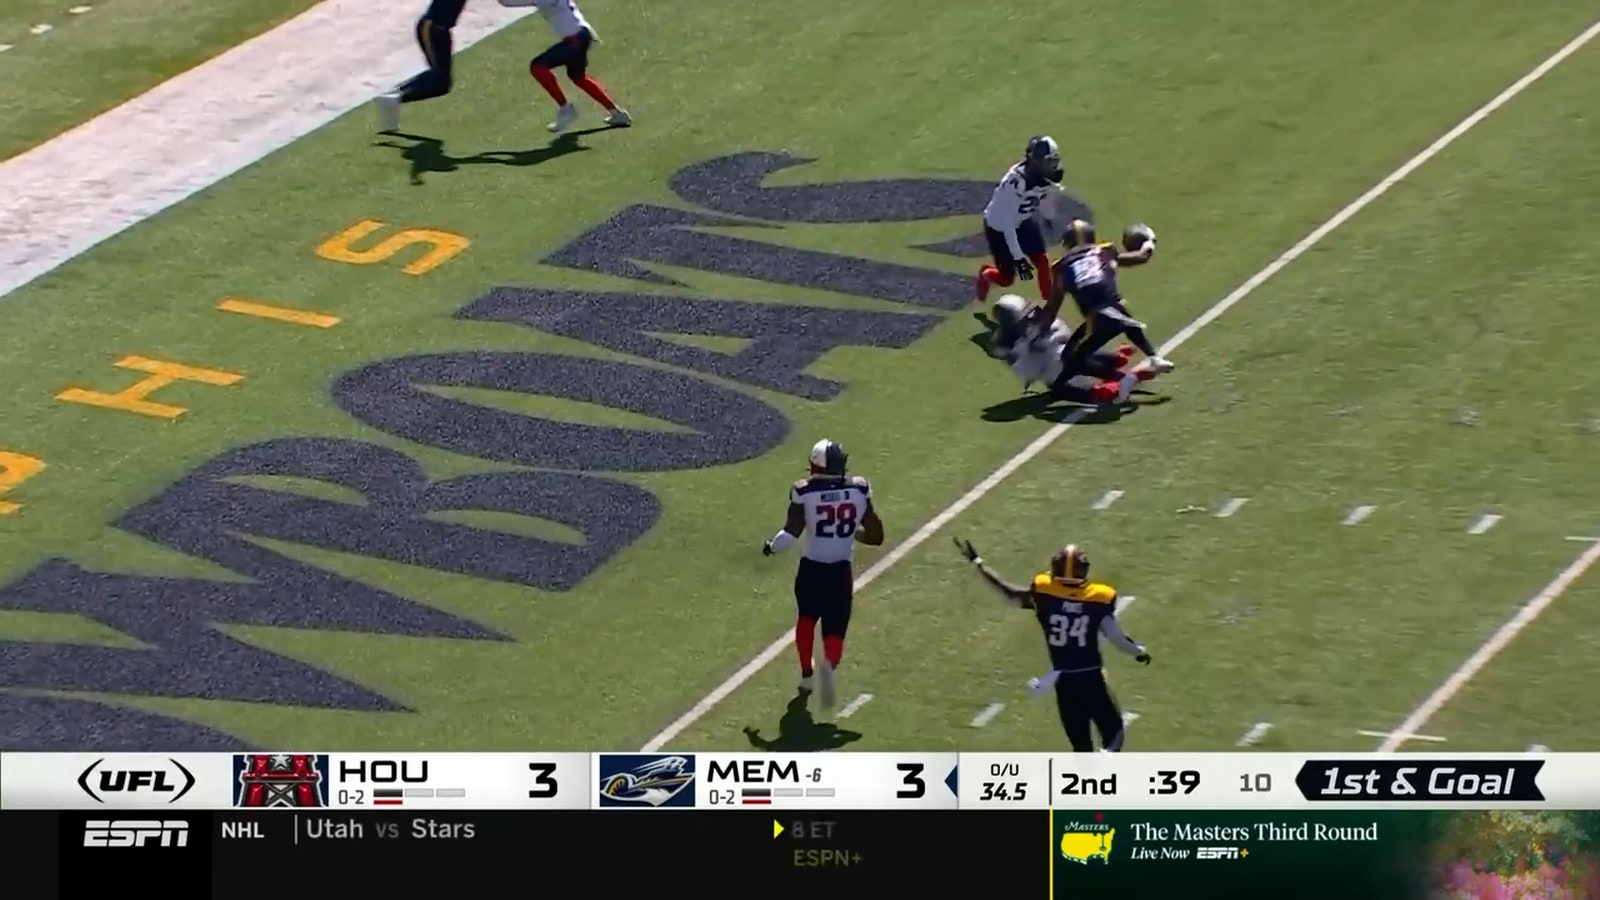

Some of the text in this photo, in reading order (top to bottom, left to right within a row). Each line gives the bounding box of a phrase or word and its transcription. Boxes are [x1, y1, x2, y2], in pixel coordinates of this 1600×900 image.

[0, 151, 1093, 752] WBOATS
[816, 503, 857, 538] 28
[1049, 614, 1090, 647] 34
